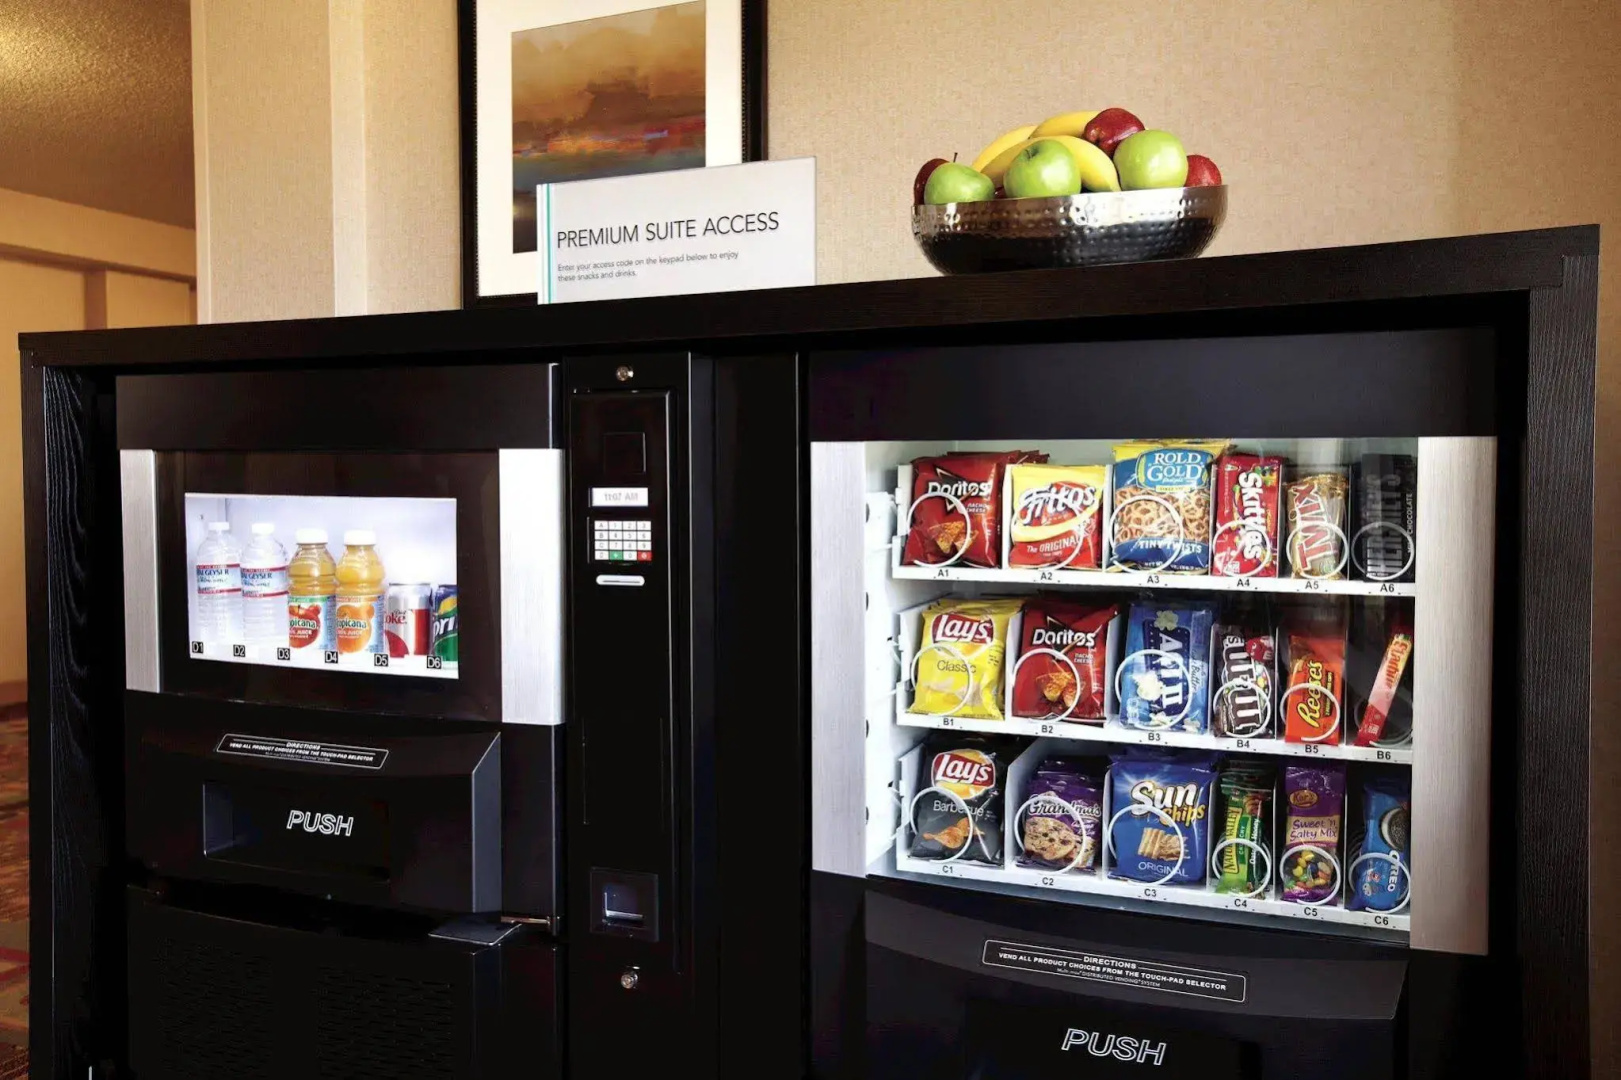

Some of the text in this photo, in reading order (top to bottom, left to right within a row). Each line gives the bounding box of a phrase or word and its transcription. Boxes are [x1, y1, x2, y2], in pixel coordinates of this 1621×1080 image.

[557, 211, 779, 248] PREMIUM SUITE ACCESS
[557, 263, 575, 272] Enter
[577, 263, 591, 272] your
[593, 261, 615, 269] access
[616, 259, 634, 267] code
[646, 257, 657, 265] the
[659, 253, 685, 265] keypad
[686, 252, 708, 262] below
[710, 252, 718, 260] to
[719, 250, 739, 260] enjoy
[557, 269, 638, 282] these snacks and drinks.
[1153, 452, 1202, 466] ROLD
[1146, 464, 1203, 482] GOLD
[928, 480, 992, 497] Doritos
[1018, 484, 1097, 526] Fritos
[1238, 471, 1267, 560] Skittles
[1405, 493, 1414, 535] CHOCOLATE
[1138, 539, 1202, 554] TINY TWISTS
[937, 569, 949, 578] A1
[1040, 571, 1053, 581] A2
[1146, 575, 1160, 584] A3
[1236, 579, 1250, 587] A4
[1304, 580, 1319, 590] A5
[1380, 583, 1395, 593] A6
[385, 612, 407, 625] oke
[935, 614, 993, 643] Lay's
[1033, 628, 1096, 647] Doritos
[192, 641, 204, 653] D1
[234, 645, 245, 657] D2
[278, 648, 290, 660] D3
[325, 652, 338, 663] D4
[375, 654, 388, 666] D5
[427, 656, 441, 669] D6
[937, 659, 977, 674] Classc
[1296, 659, 1323, 729] Reese's
[943, 717, 954, 726] B1
[1041, 725, 1053, 734] B2
[1148, 732, 1161, 741] B3
[286, 741, 321, 751] DIRECTIONS
[1236, 739, 1250, 748] B4
[1304, 744, 1319, 754] B5
[274, 746, 296, 754] CHOICES
[320, 751, 348, 759] TOUCH-PAD
[347, 754, 374, 762] SELECTOR
[1376, 750, 1391, 760] B6
[935, 754, 992, 784] Lay's
[1130, 780, 1198, 816] Sun
[933, 799, 984, 817] Barbeue
[1158, 804, 1206, 828] Chips
[286, 809, 354, 837] PUSH
[1292, 819, 1325, 830] Sweet
[1223, 807, 1240, 871] NATU VALLEY
[1238, 825, 1246, 855] CRCHY
[1289, 828, 1337, 842] Salty Mix
[942, 865, 954, 874] C1
[1138, 861, 1189, 877] ORIGINAL
[1387, 849, 1401, 892] OREO
[1042, 877, 1054, 886] C2
[1143, 888, 1157, 898] C3
[1234, 898, 1248, 908] C4
[1303, 907, 1318, 917] C5
[1374, 916, 1389, 926] C6
[1083, 955, 1137, 970] DIRECTIONS
[998, 952, 1018, 960] VEND
[1033, 957, 1067, 967] PRODUCT
[1068, 962, 1101, 972] CHOICES
[1102, 967, 1123, 975] FROM
[1125, 970, 1139, 978] THE
[1141, 972, 1184, 984] TOUCH-PAD
[1185, 979, 1227, 991] SELECTOR
[1060, 1027, 1167, 1066] PUSH
